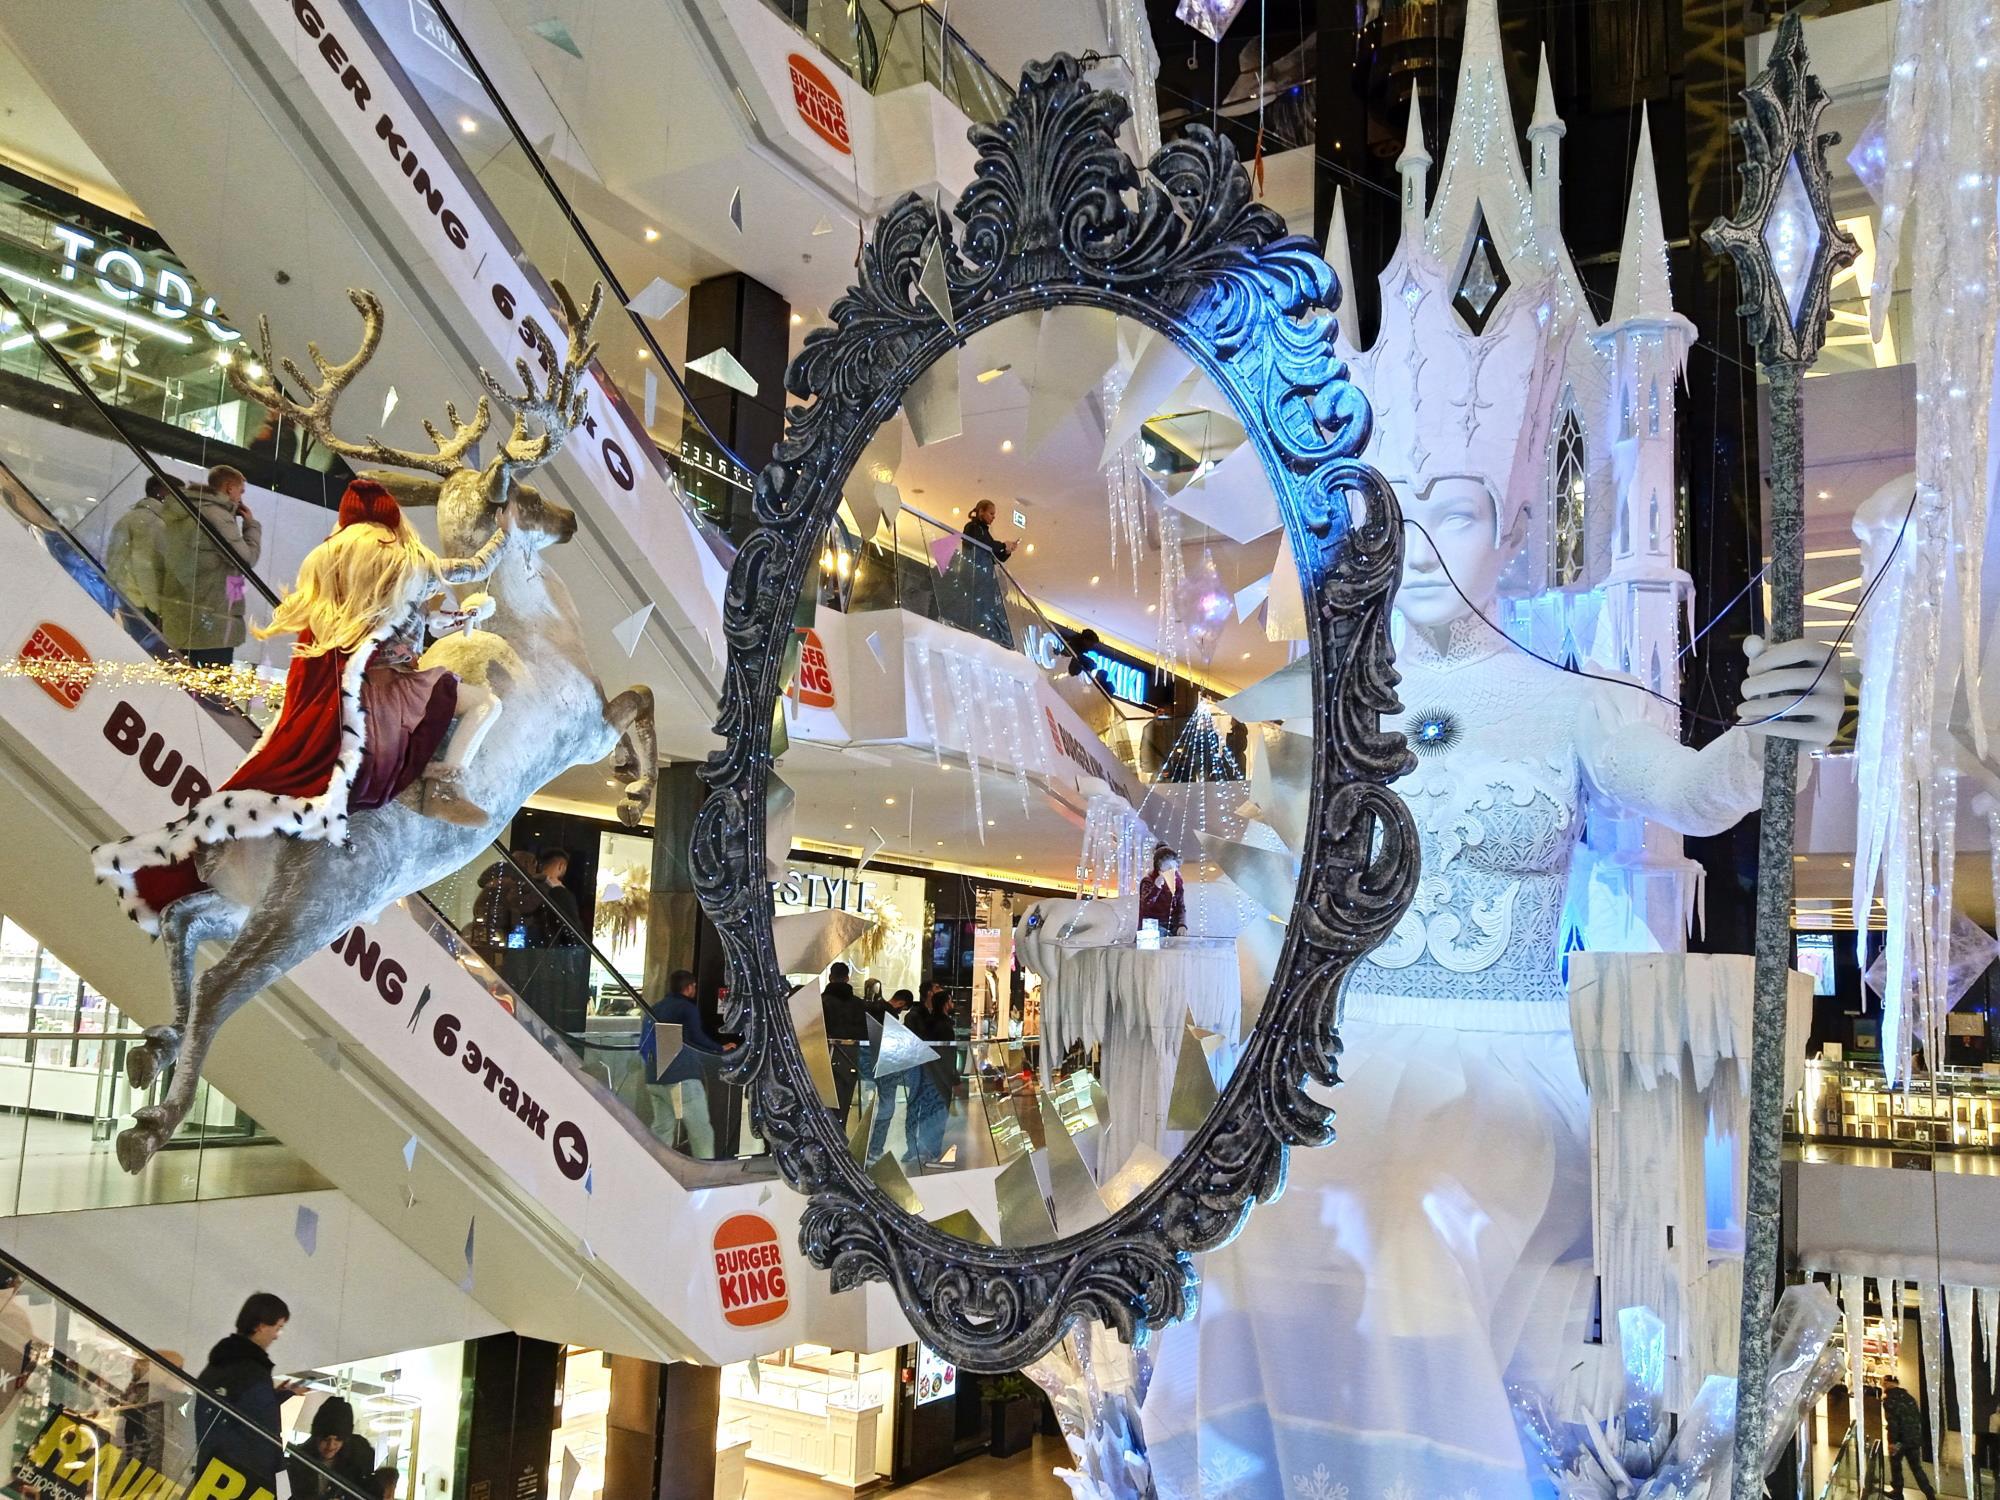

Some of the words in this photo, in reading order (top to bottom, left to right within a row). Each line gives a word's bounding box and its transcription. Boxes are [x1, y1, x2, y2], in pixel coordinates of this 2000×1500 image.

[790, 66, 846, 124] BURGER
[793, 83, 850, 144] KING
[289, 0, 371, 111] GER
[375, 113, 469, 250] KING
[492, 283, 516, 320] 6
[801, 664, 832, 694] NG
[103, 701, 213, 817] BUR
[773, 871, 878, 914] STYLE
[330, 925, 408, 1005] ING
[433, 1014, 461, 1056] 6
[461, 1040, 550, 1140] этаж
[715, 1244, 782, 1275] BURGER
[719, 1267, 786, 1309] KING
